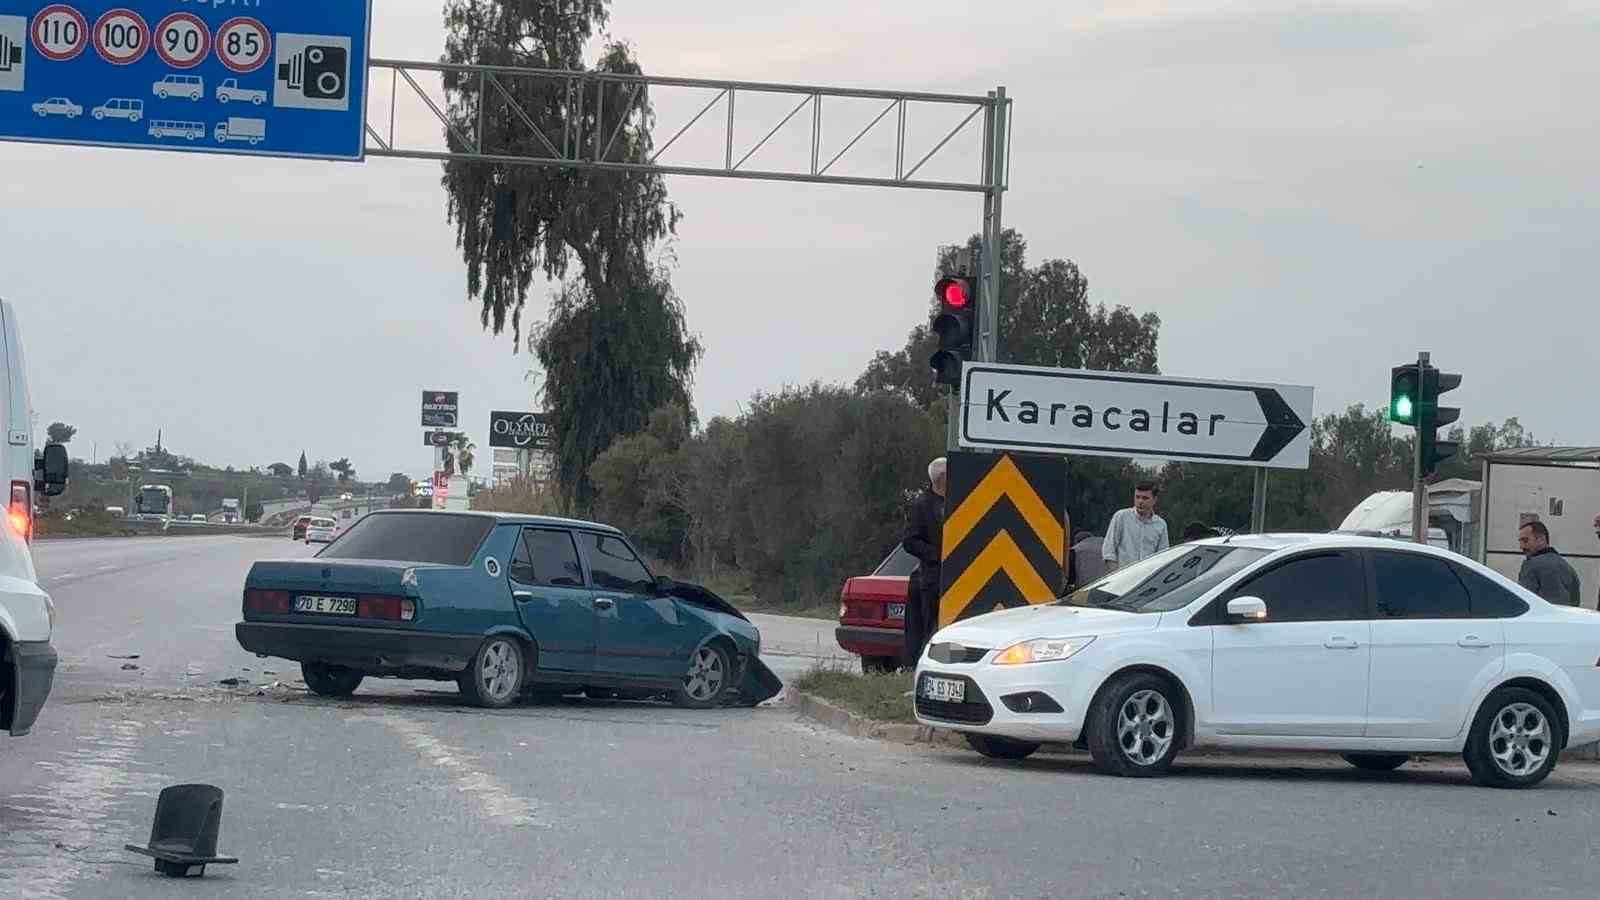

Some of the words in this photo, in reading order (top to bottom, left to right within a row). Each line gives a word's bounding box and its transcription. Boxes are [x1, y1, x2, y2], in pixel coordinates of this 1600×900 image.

[42, 18, 79, 45] 110
[104, 23, 140, 49] 100
[165, 28, 198, 53] 90
[227, 32, 259, 56] 85
[986, 389, 1225, 435] Karacalar
[297, 597, 313, 610] 70
[317, 597, 325, 611] E
